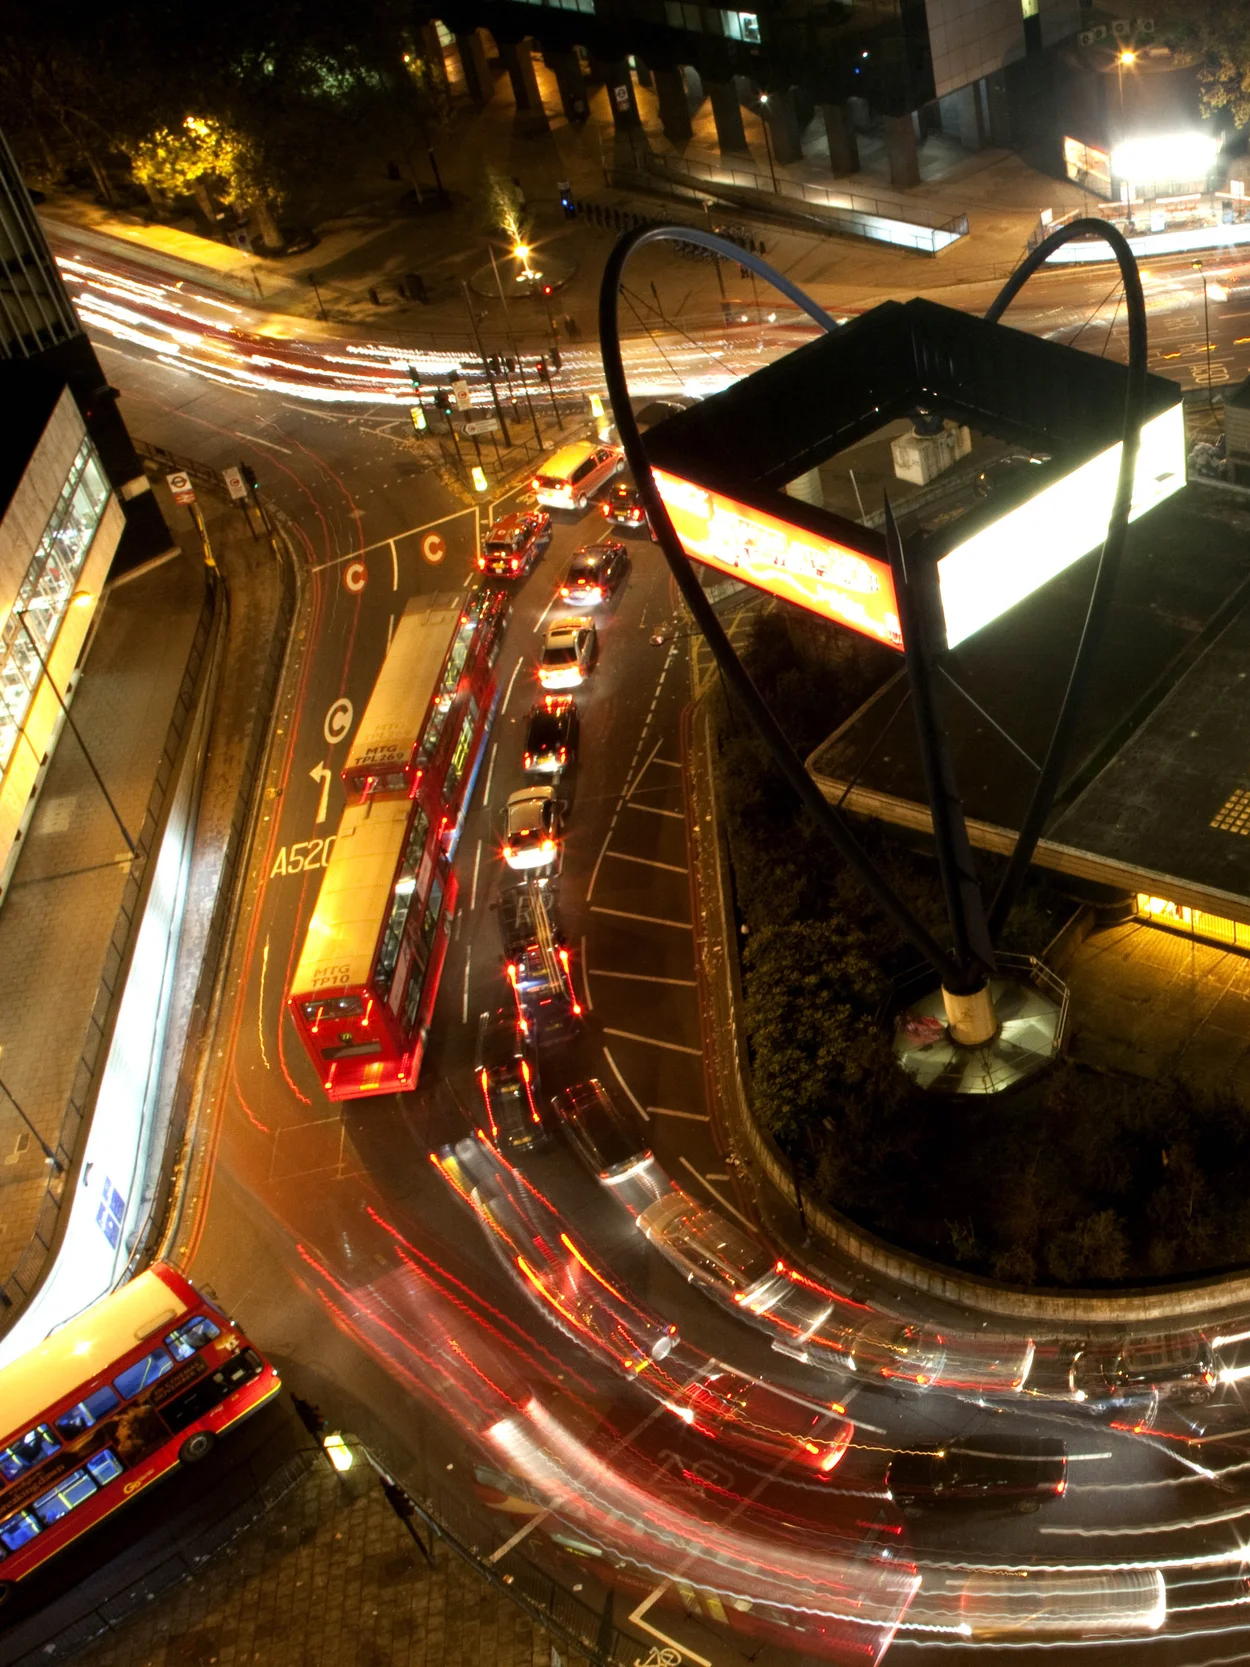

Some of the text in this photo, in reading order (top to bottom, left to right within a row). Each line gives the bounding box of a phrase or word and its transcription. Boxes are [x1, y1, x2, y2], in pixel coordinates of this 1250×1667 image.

[424, 535, 444, 562] C
[346, 564, 365, 591] C
[326, 702, 350, 739] C
[365, 744, 398, 755] MTG
[354, 752, 404, 765] TPL269
[313, 964, 351, 978] MTG
[311, 974, 350, 988] TP10
